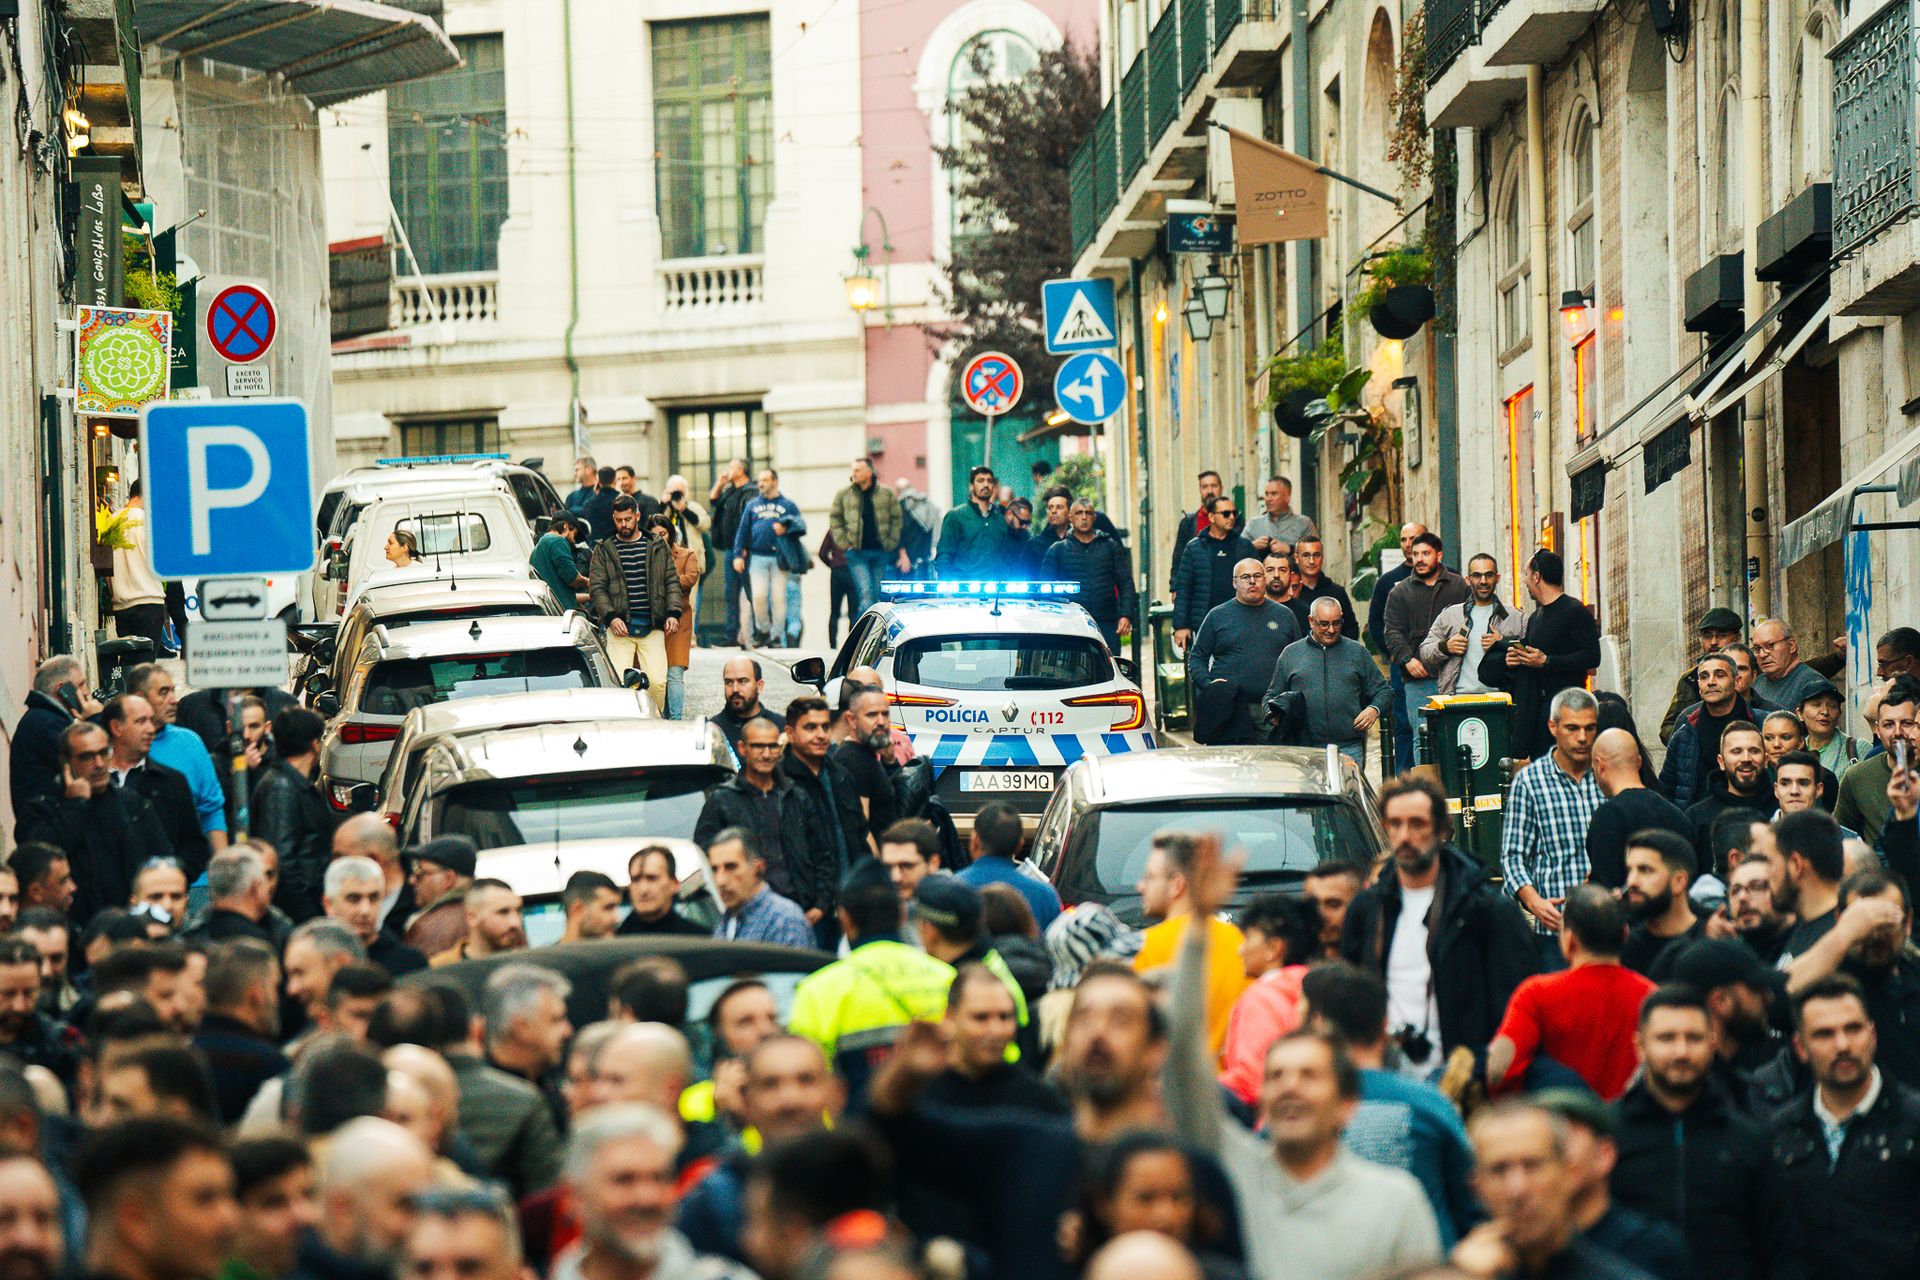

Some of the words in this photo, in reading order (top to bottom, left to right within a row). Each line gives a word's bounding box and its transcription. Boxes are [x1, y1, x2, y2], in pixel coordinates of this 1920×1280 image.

[1254, 188, 1307, 202] ZOTTO
[187, 426, 271, 556] P
[925, 704, 990, 723] POLÍCIA
[1039, 711, 1064, 724] 112
[973, 727, 1046, 735] CAPTUR
